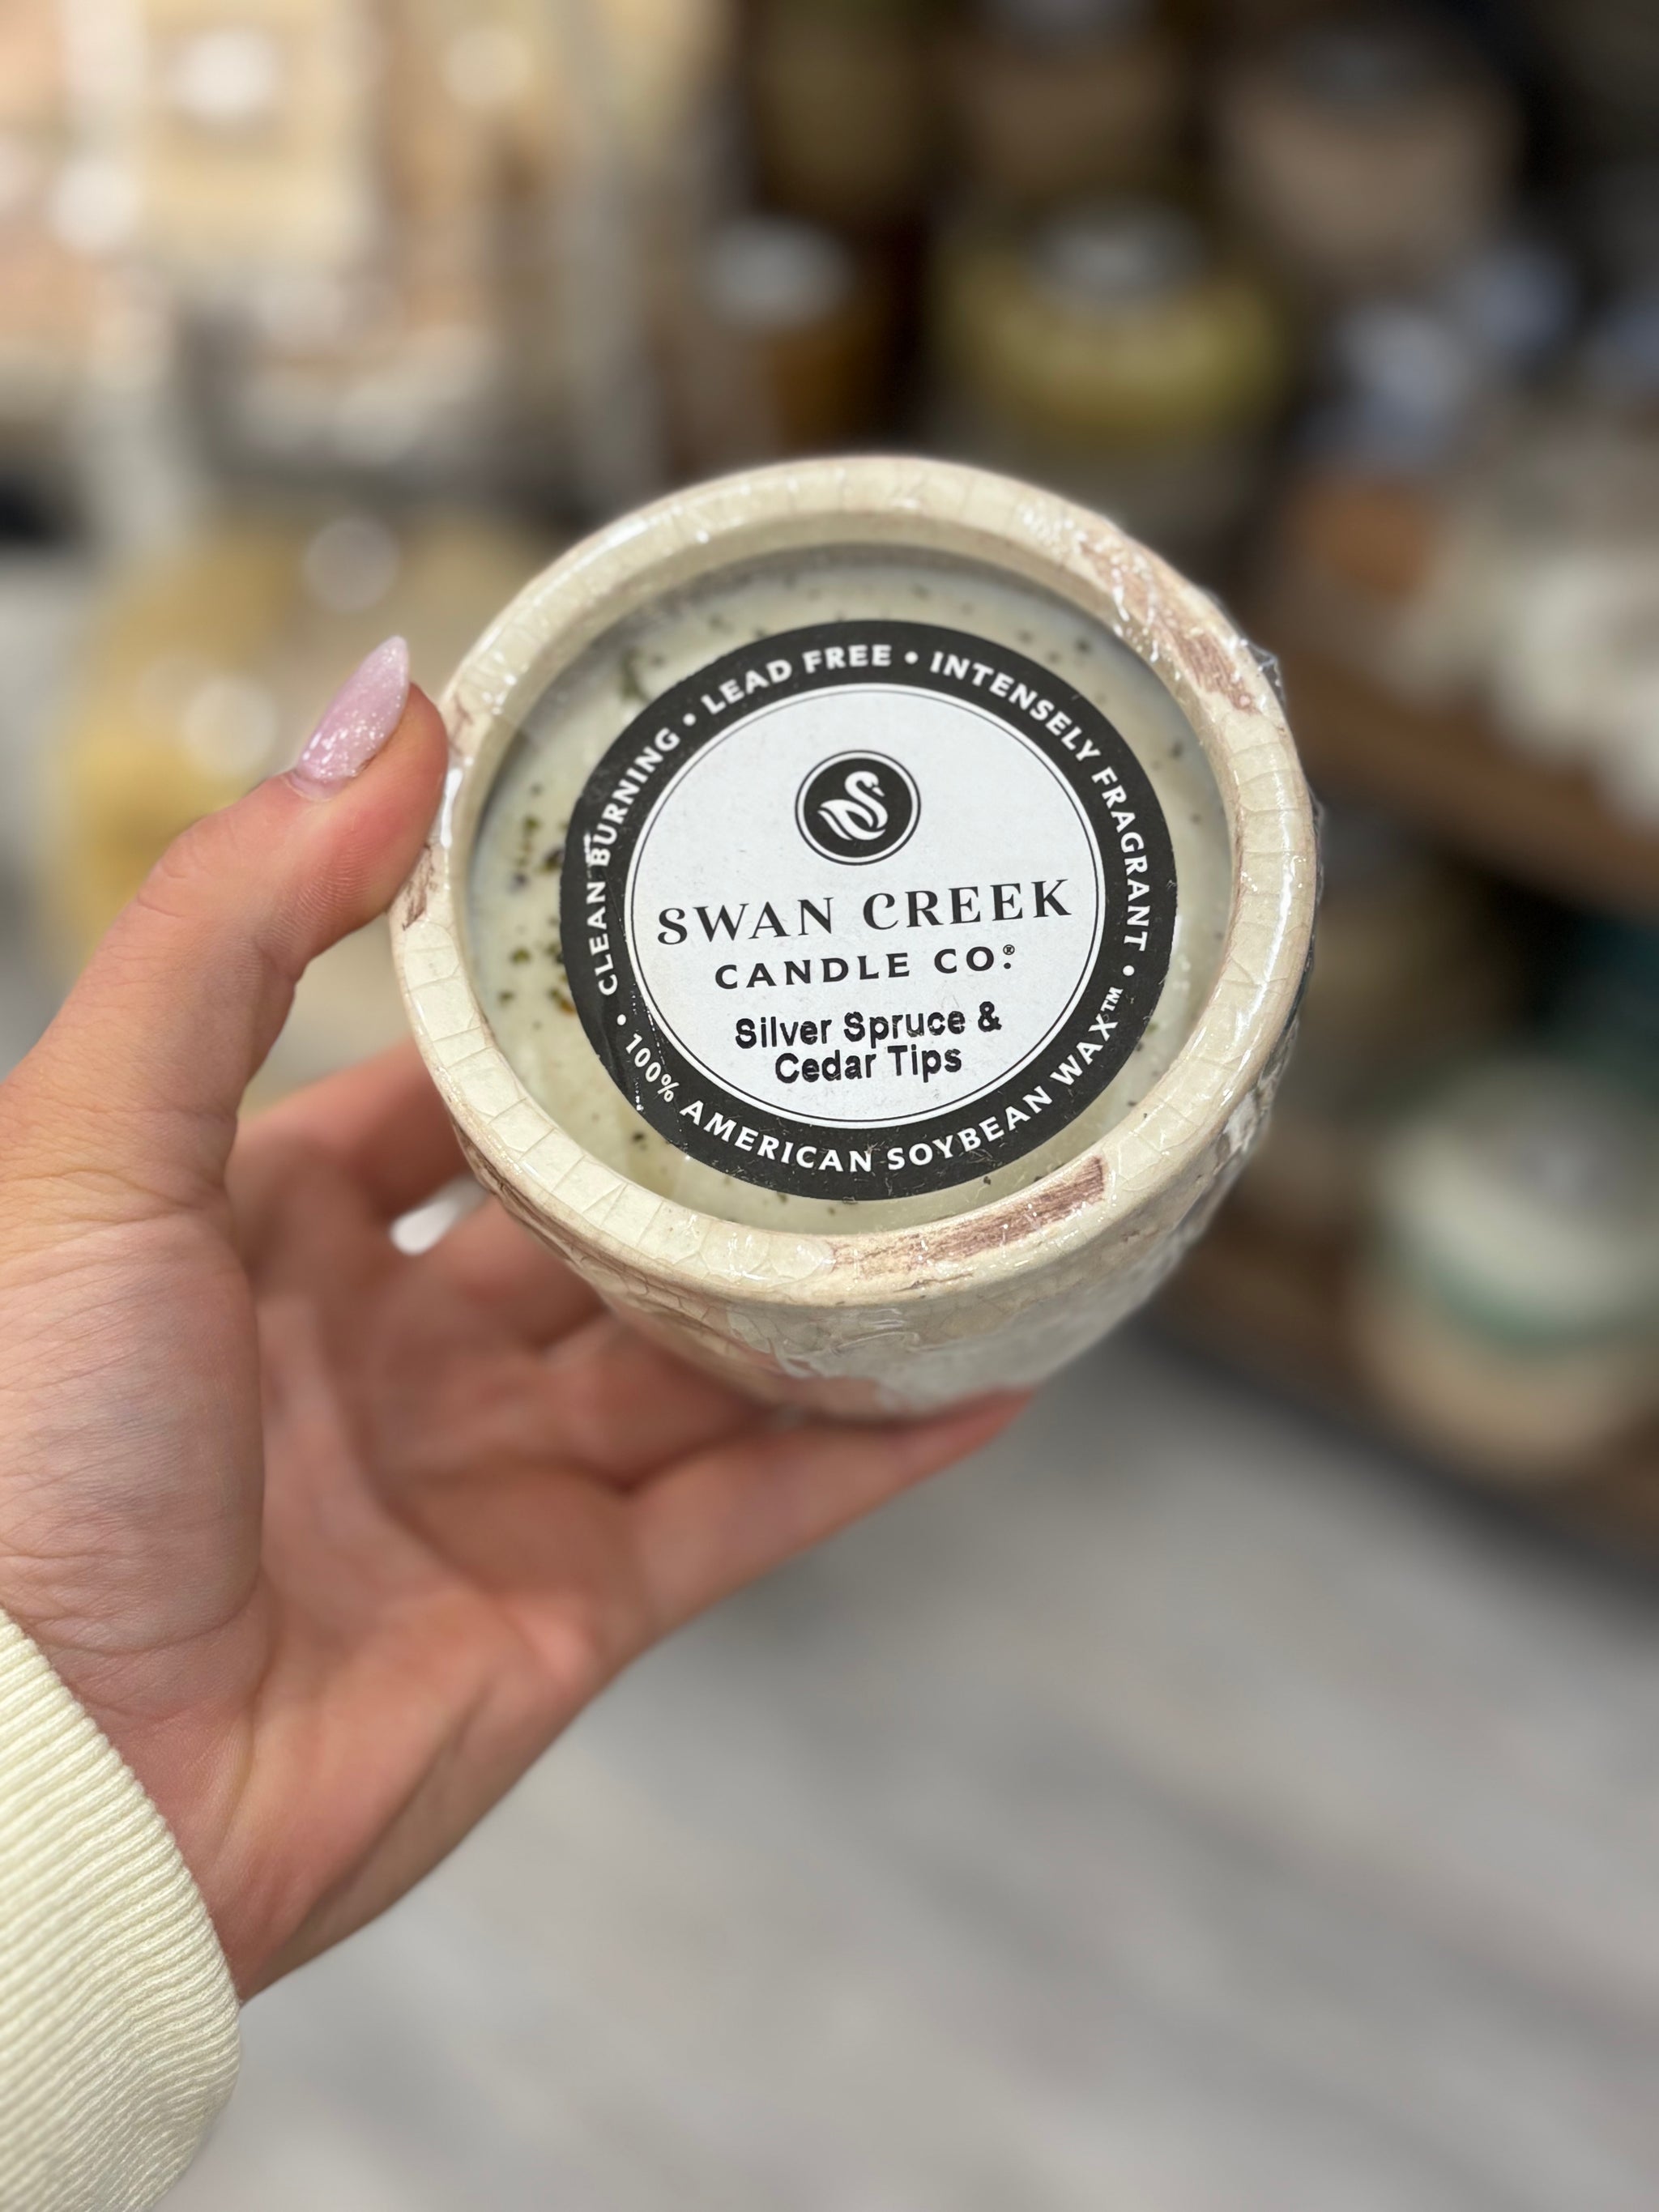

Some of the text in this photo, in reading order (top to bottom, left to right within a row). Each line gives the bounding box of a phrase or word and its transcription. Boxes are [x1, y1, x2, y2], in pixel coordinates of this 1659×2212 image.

[702, 645, 892, 714] LEAD FREE
[931, 651, 1149, 951] INTENSELY FRAGRANT
[590, 728, 681, 995] CLEAN BURNING
[657, 879, 1071, 946] SWAN CREEK
[715, 953, 911, 990] CANDLE
[736, 1002, 1001, 1048] Silver Spruce &
[775, 1045, 962, 1084] Cedar Tips
[625, 1036, 676, 1102] 100%
[680, 1101, 872, 1173] AMERICAN
[888, 1086, 1053, 1170] SOYBEAN
